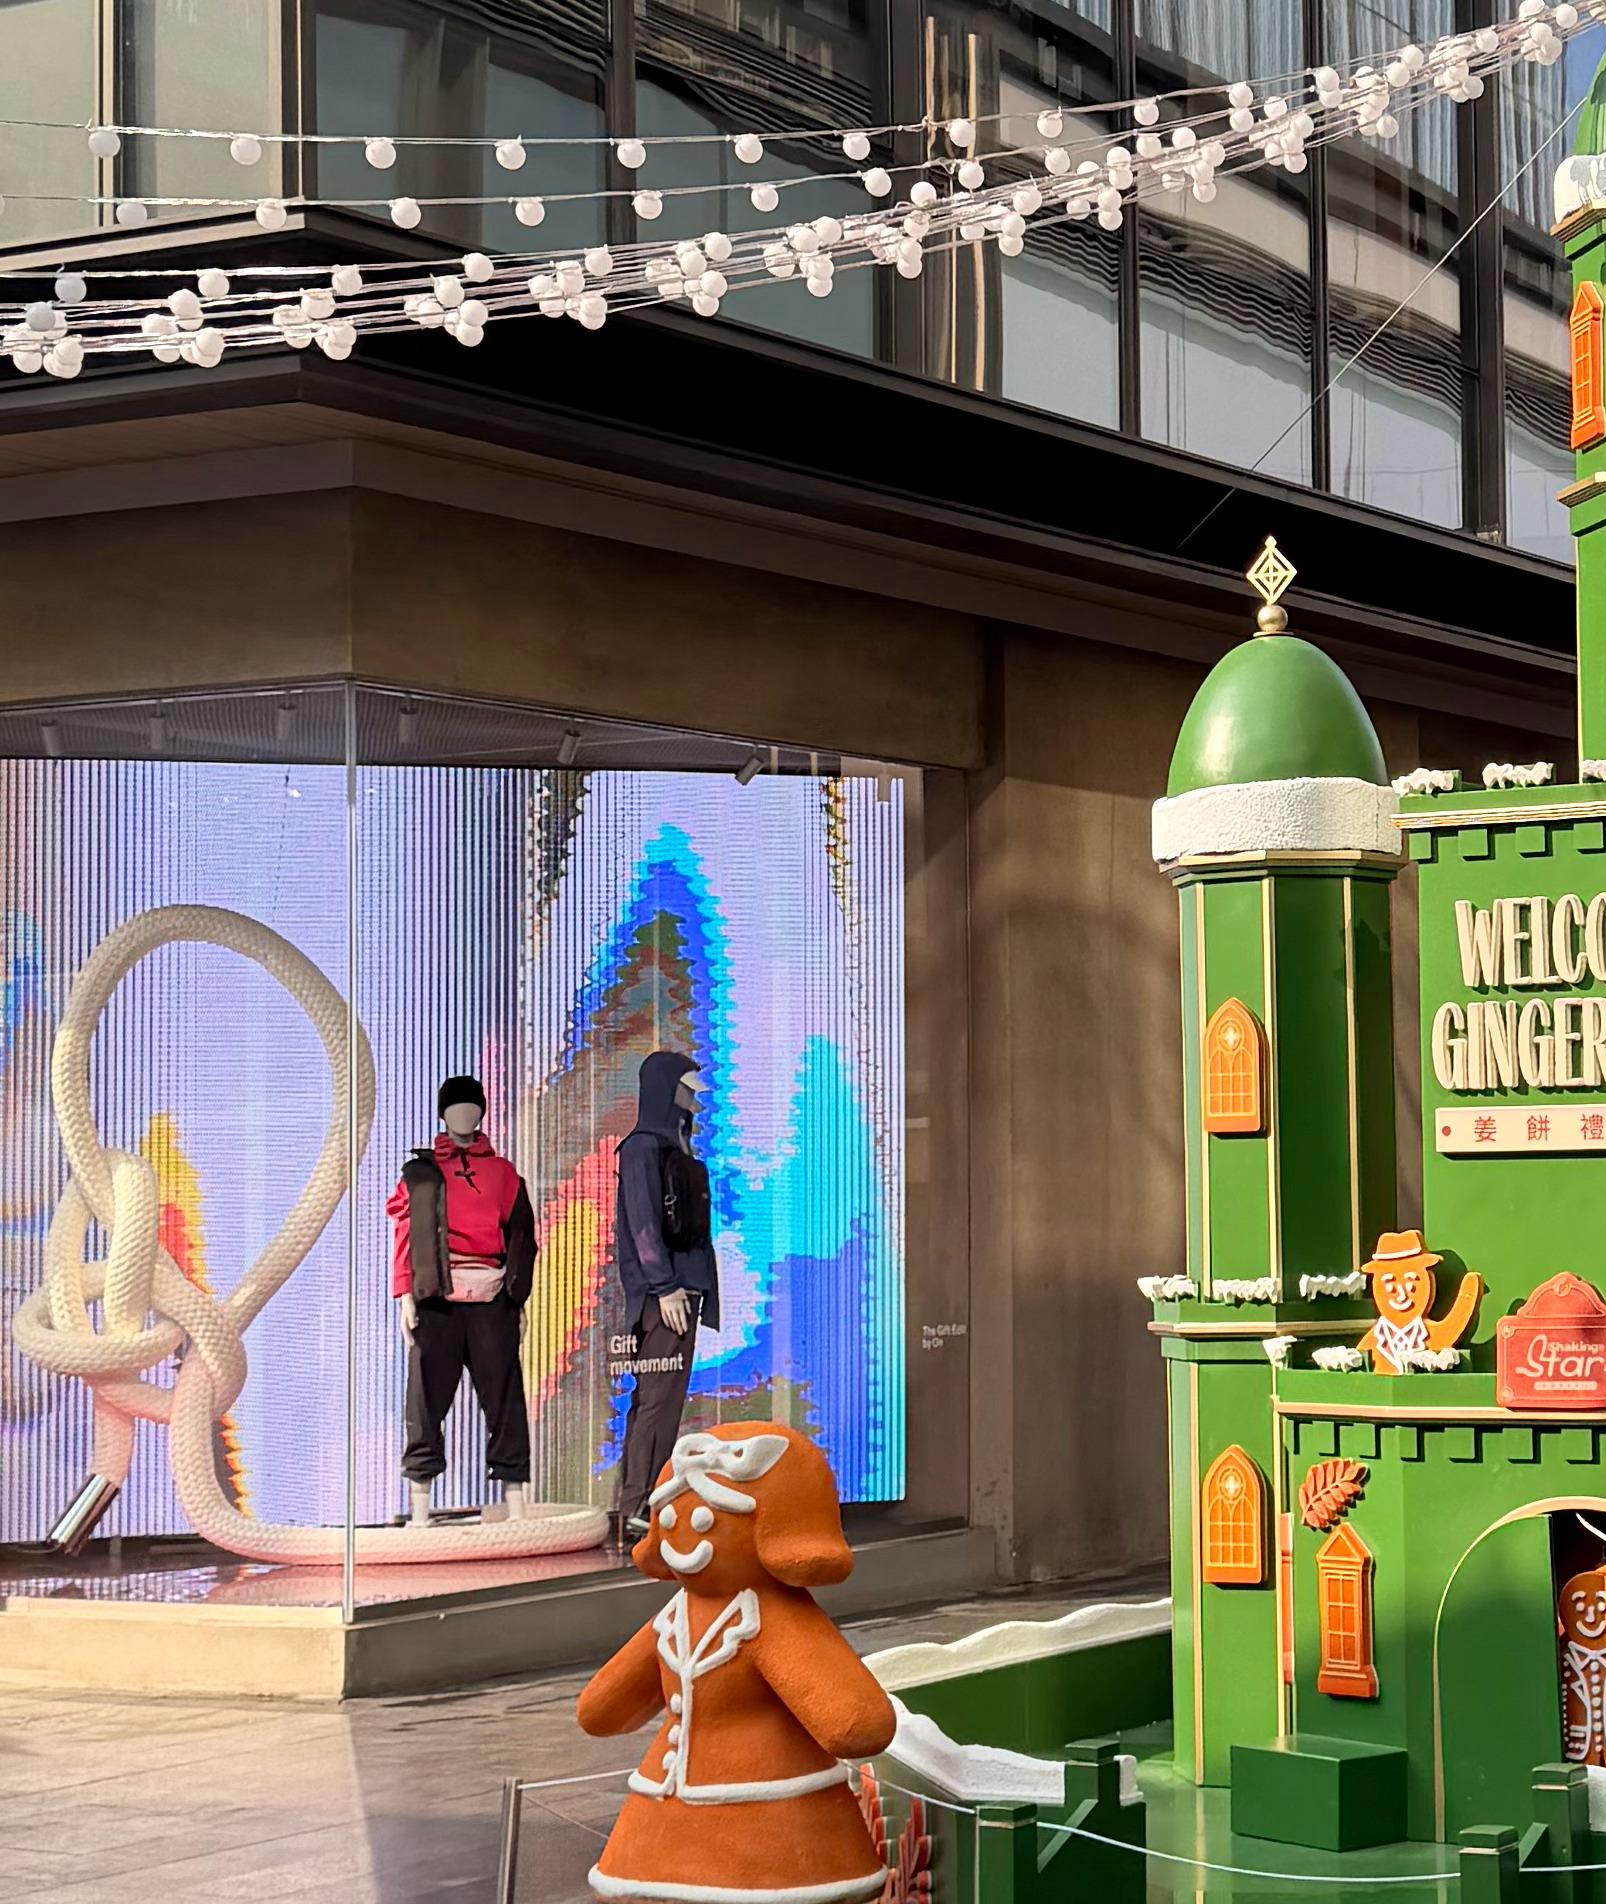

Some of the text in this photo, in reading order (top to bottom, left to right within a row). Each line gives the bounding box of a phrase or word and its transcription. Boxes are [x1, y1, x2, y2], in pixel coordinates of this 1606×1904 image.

[610, 1334, 638, 1354] Gift
[610, 1353, 684, 1376] movement
[1515, 1334, 1605, 1378] Star
